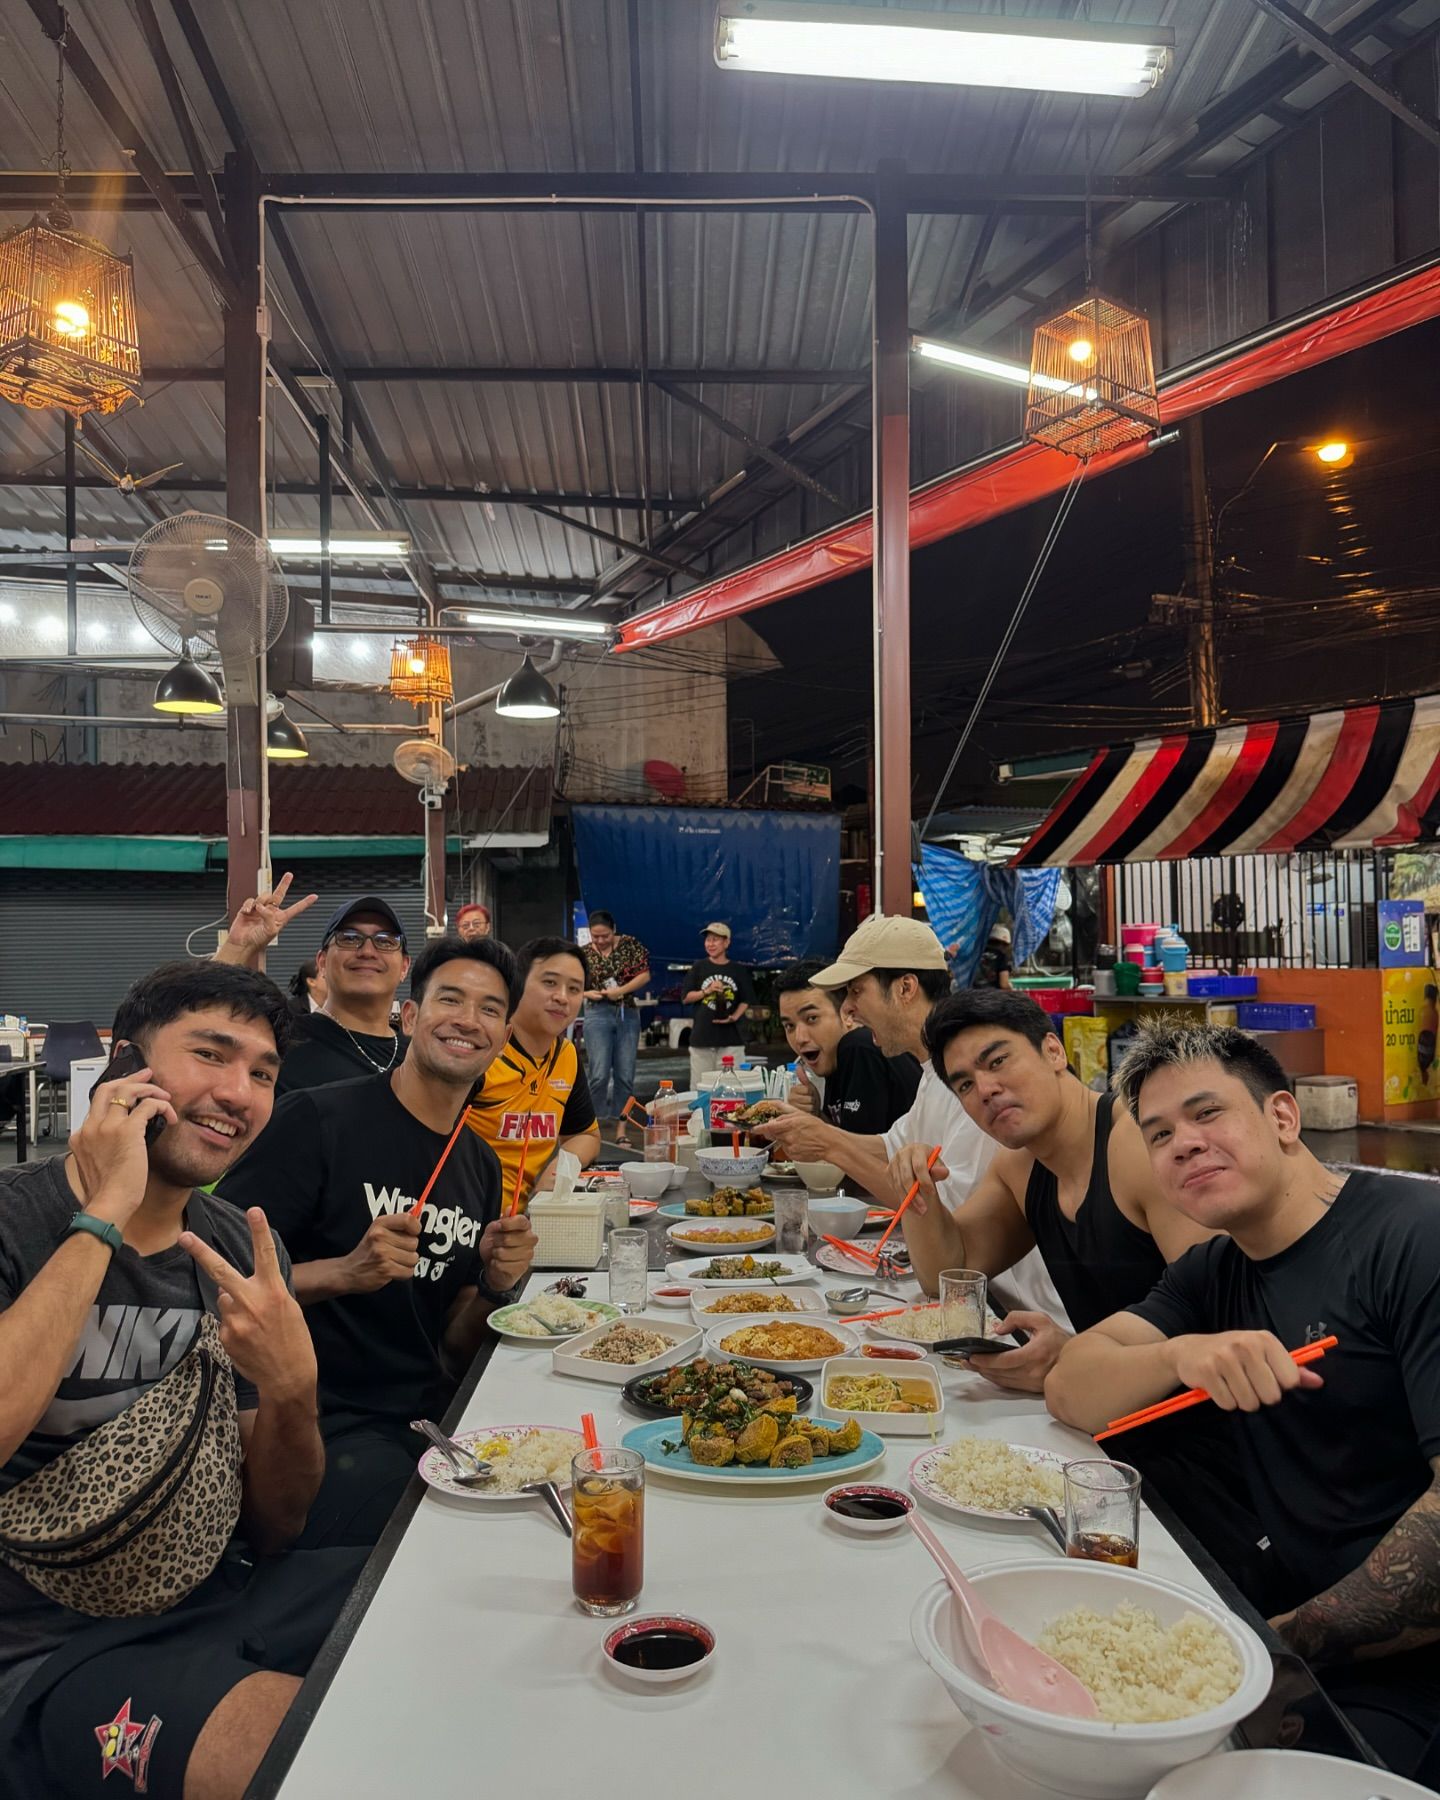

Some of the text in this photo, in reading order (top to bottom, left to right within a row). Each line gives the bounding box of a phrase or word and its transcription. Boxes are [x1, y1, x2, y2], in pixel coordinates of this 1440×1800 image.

[1385, 1000, 1415, 1025] น้ำส้ม
[1386, 1034, 1397, 1047] 20
[363, 1182, 481, 1255] Wrngler
